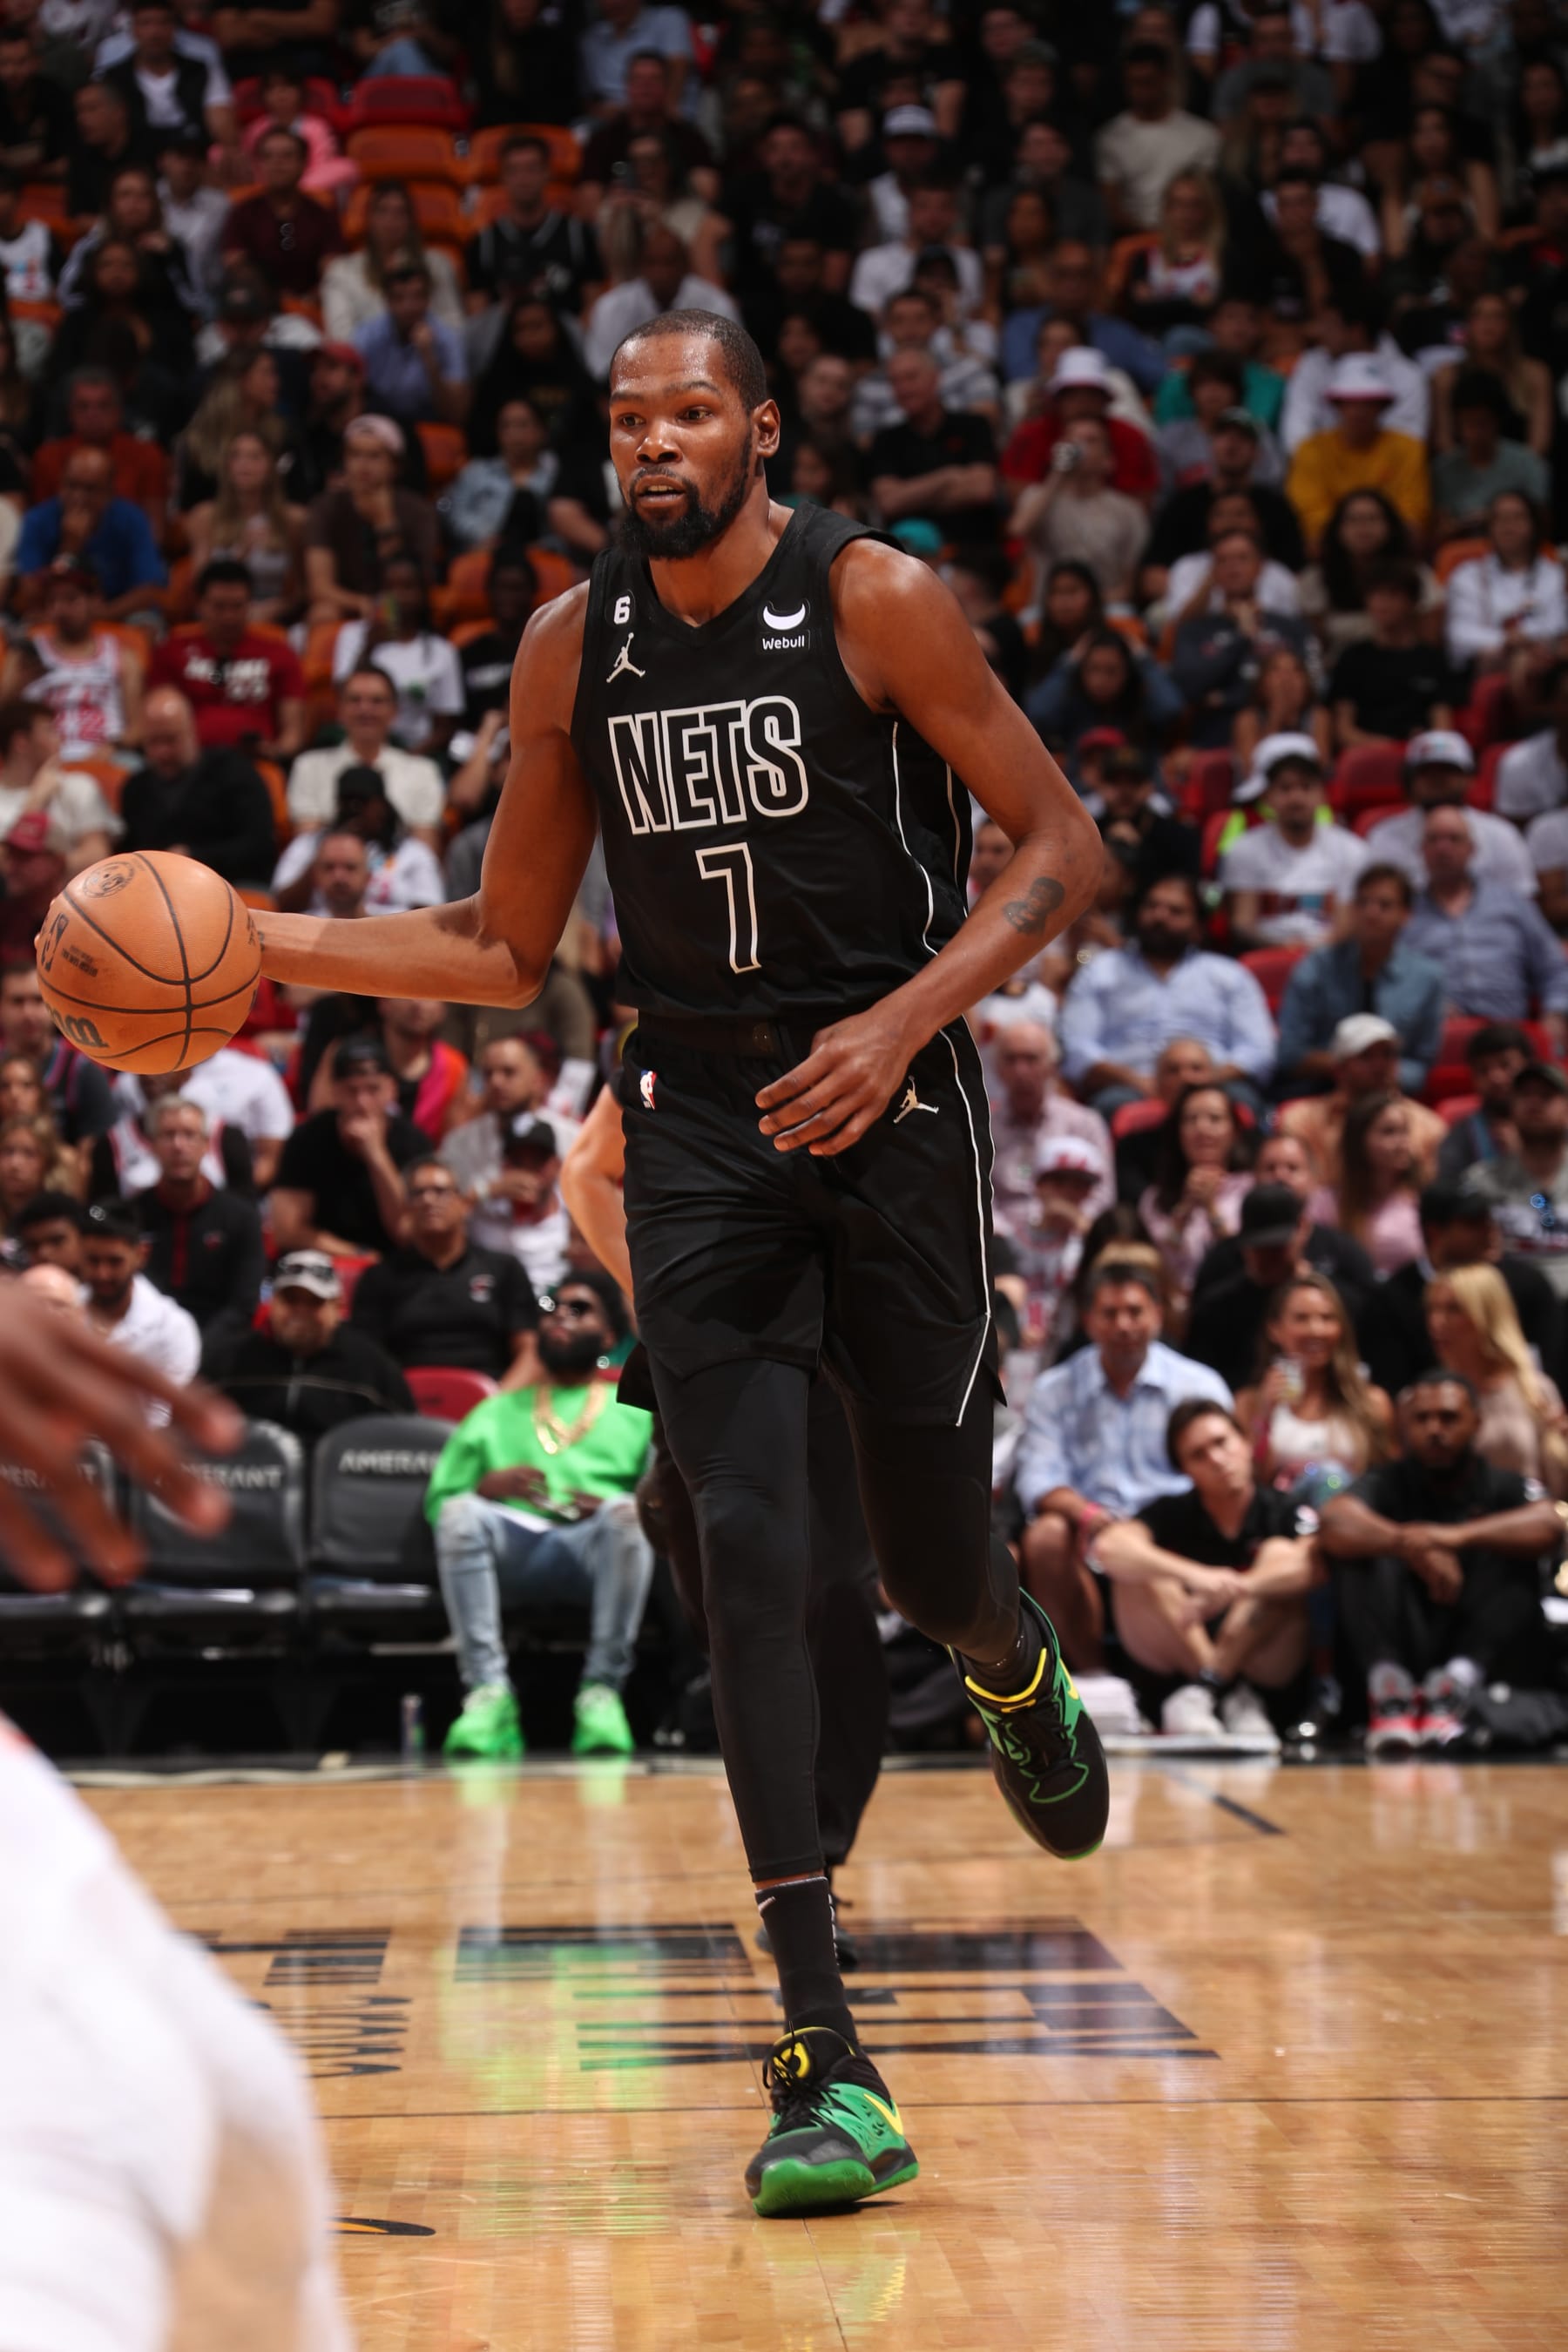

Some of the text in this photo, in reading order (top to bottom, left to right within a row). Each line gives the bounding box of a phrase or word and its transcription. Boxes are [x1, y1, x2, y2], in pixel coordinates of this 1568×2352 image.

[613, 595, 631, 625] 6
[762, 635, 805, 651] Webull
[607, 695, 809, 835] NETS
[695, 841, 762, 974] 7
[171, 1463, 282, 1490] ERANT
[338, 1449, 439, 1476] AMERA
